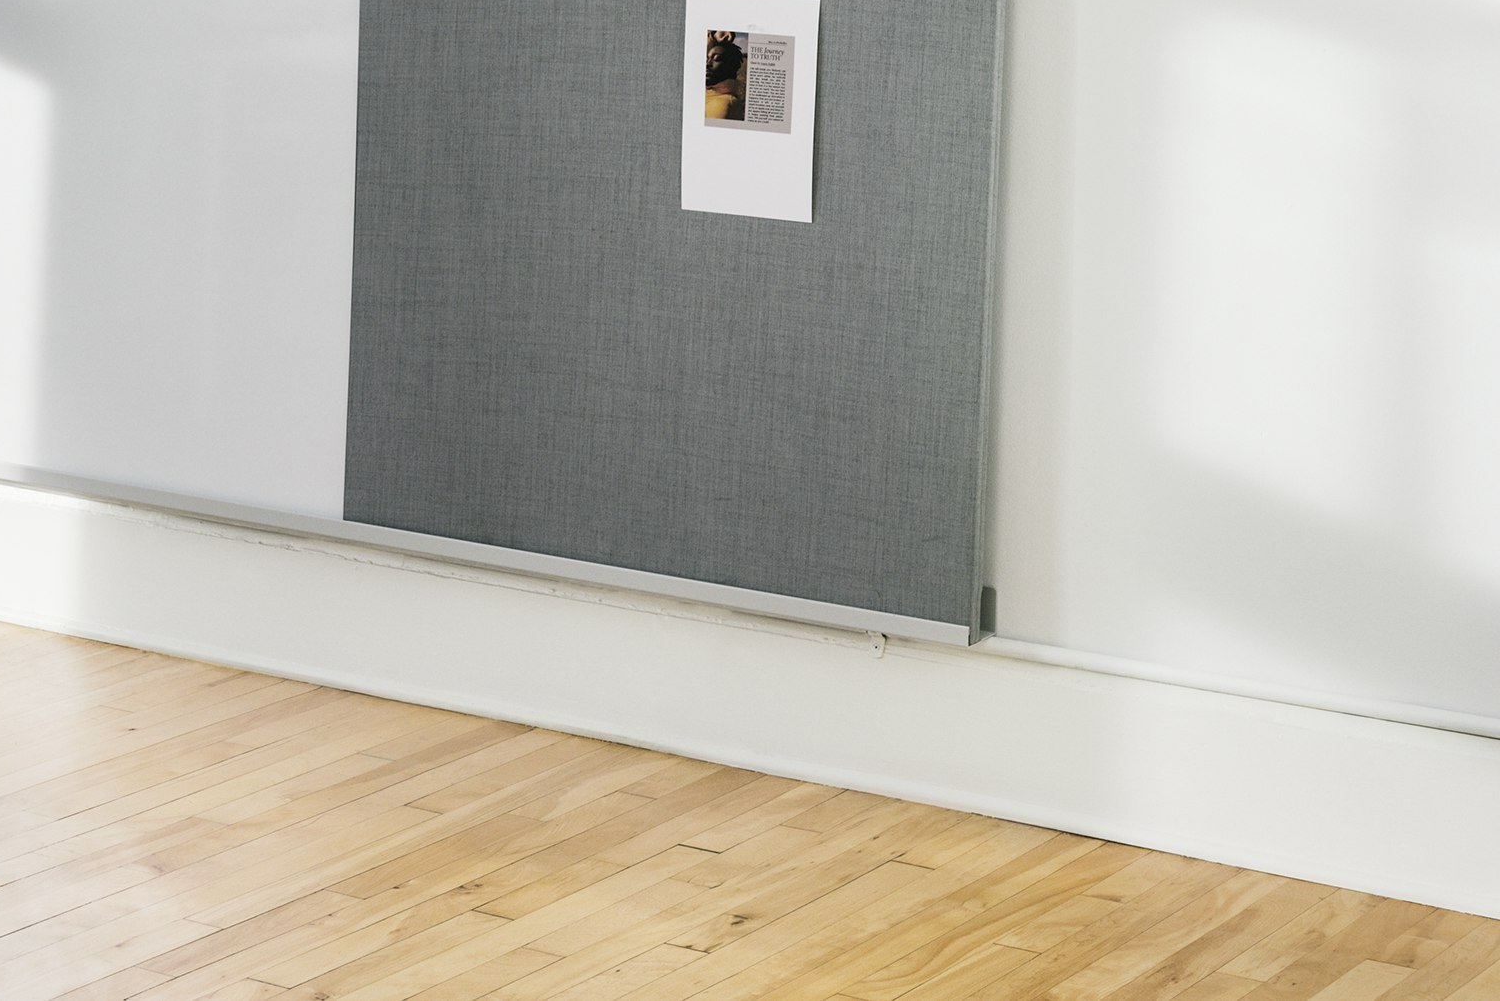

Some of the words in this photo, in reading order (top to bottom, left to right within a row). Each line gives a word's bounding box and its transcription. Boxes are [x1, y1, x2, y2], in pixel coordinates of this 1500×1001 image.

[750, 46, 764, 54] THE
[764, 46, 785, 57] Journey
[760, 53, 781, 62] TRUTH
